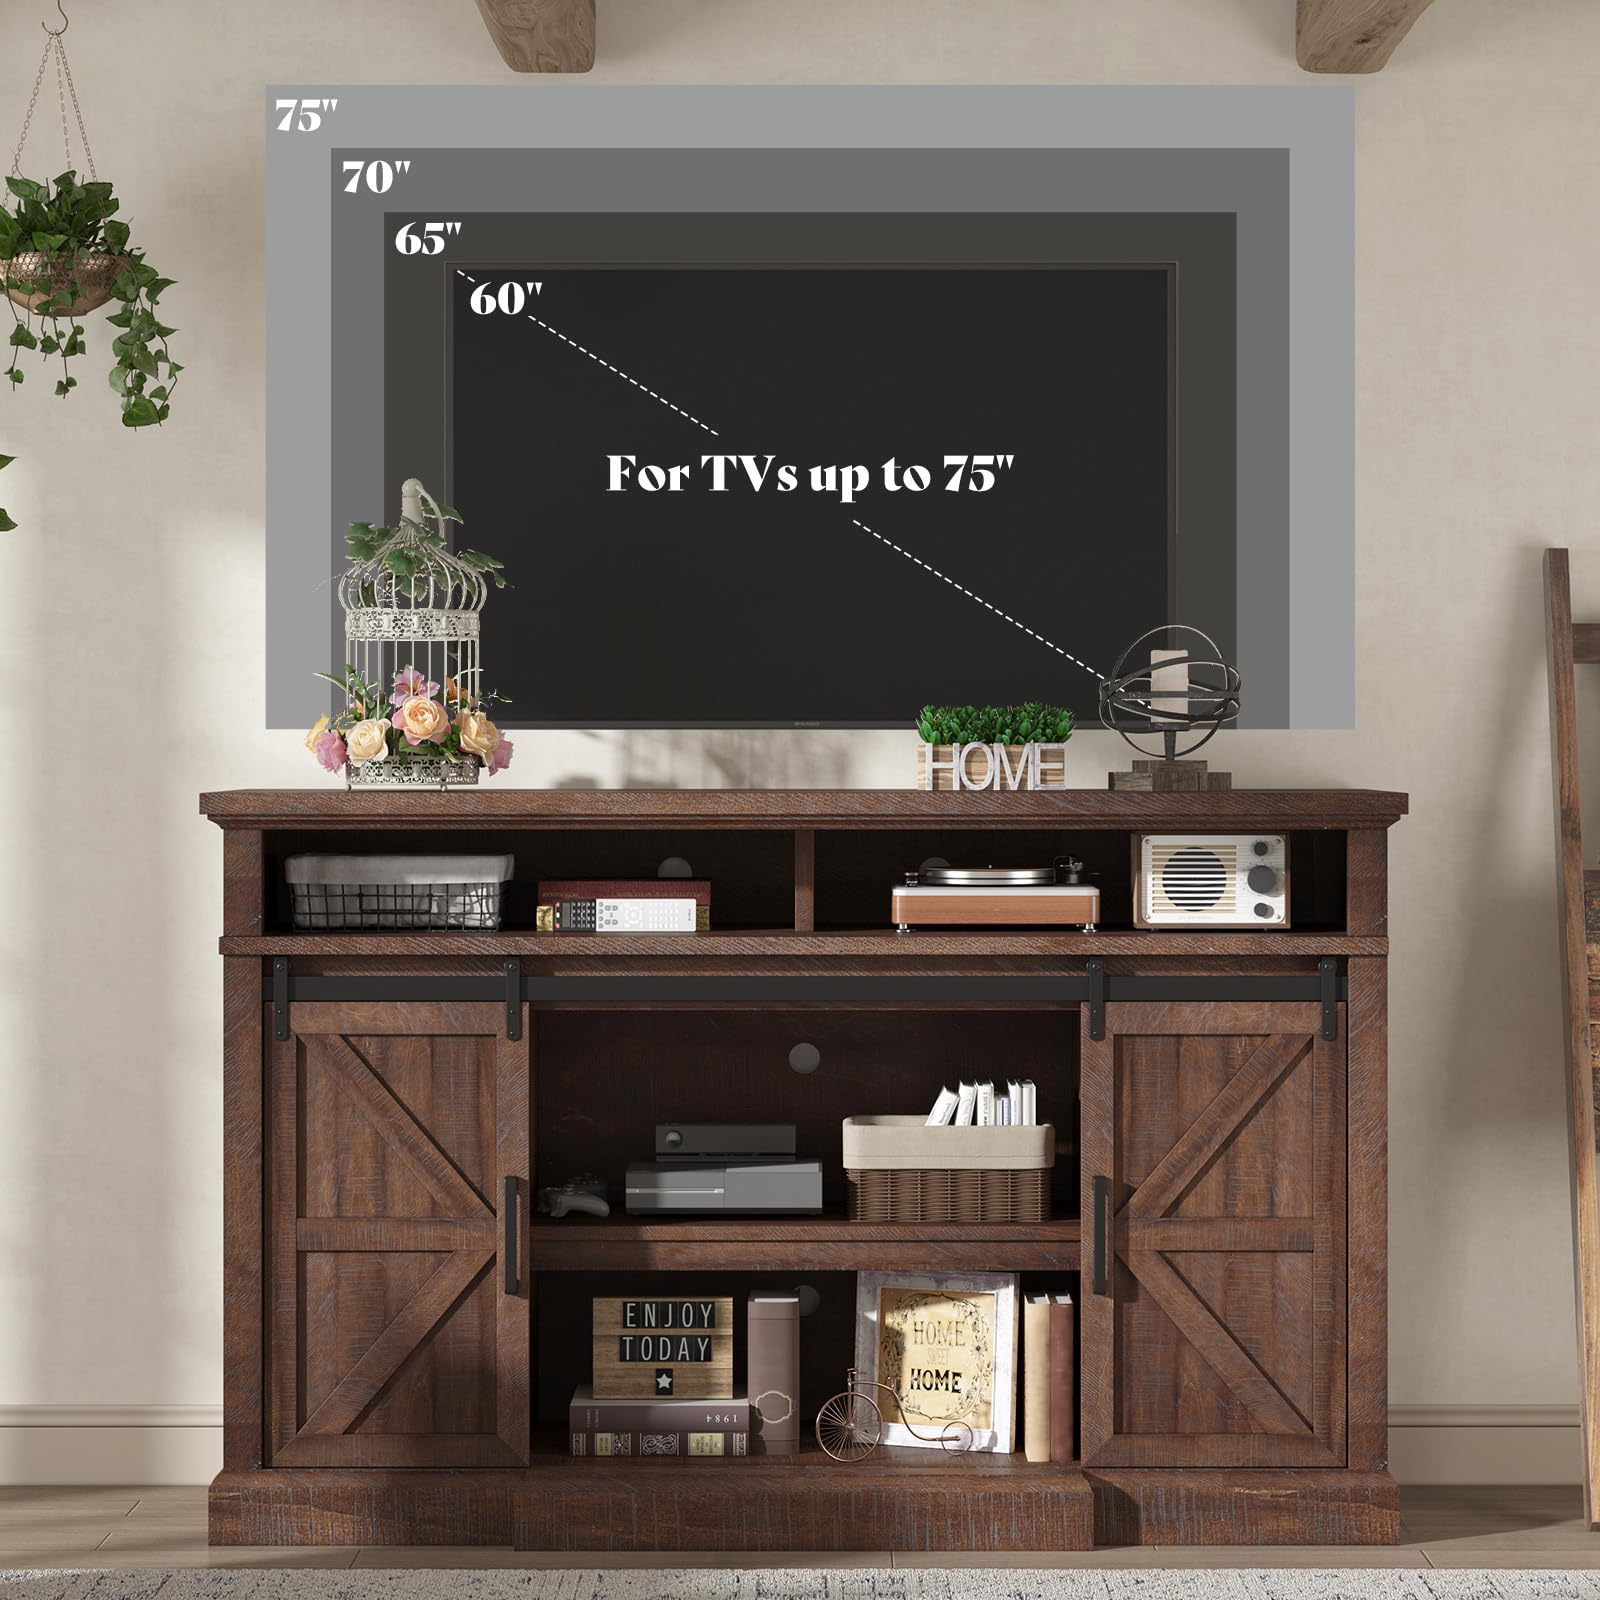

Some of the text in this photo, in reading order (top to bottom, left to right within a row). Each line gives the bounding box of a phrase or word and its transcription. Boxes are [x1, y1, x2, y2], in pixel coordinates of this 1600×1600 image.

[925, 741, 1066, 791] HOME
[626, 1303, 712, 1328] ENJOY
[913, 1320, 965, 1346] HOME
[622, 1336, 709, 1361] TODAY
[910, 1367, 962, 1394] HOME
[706, 1414, 737, 1423] 1984
